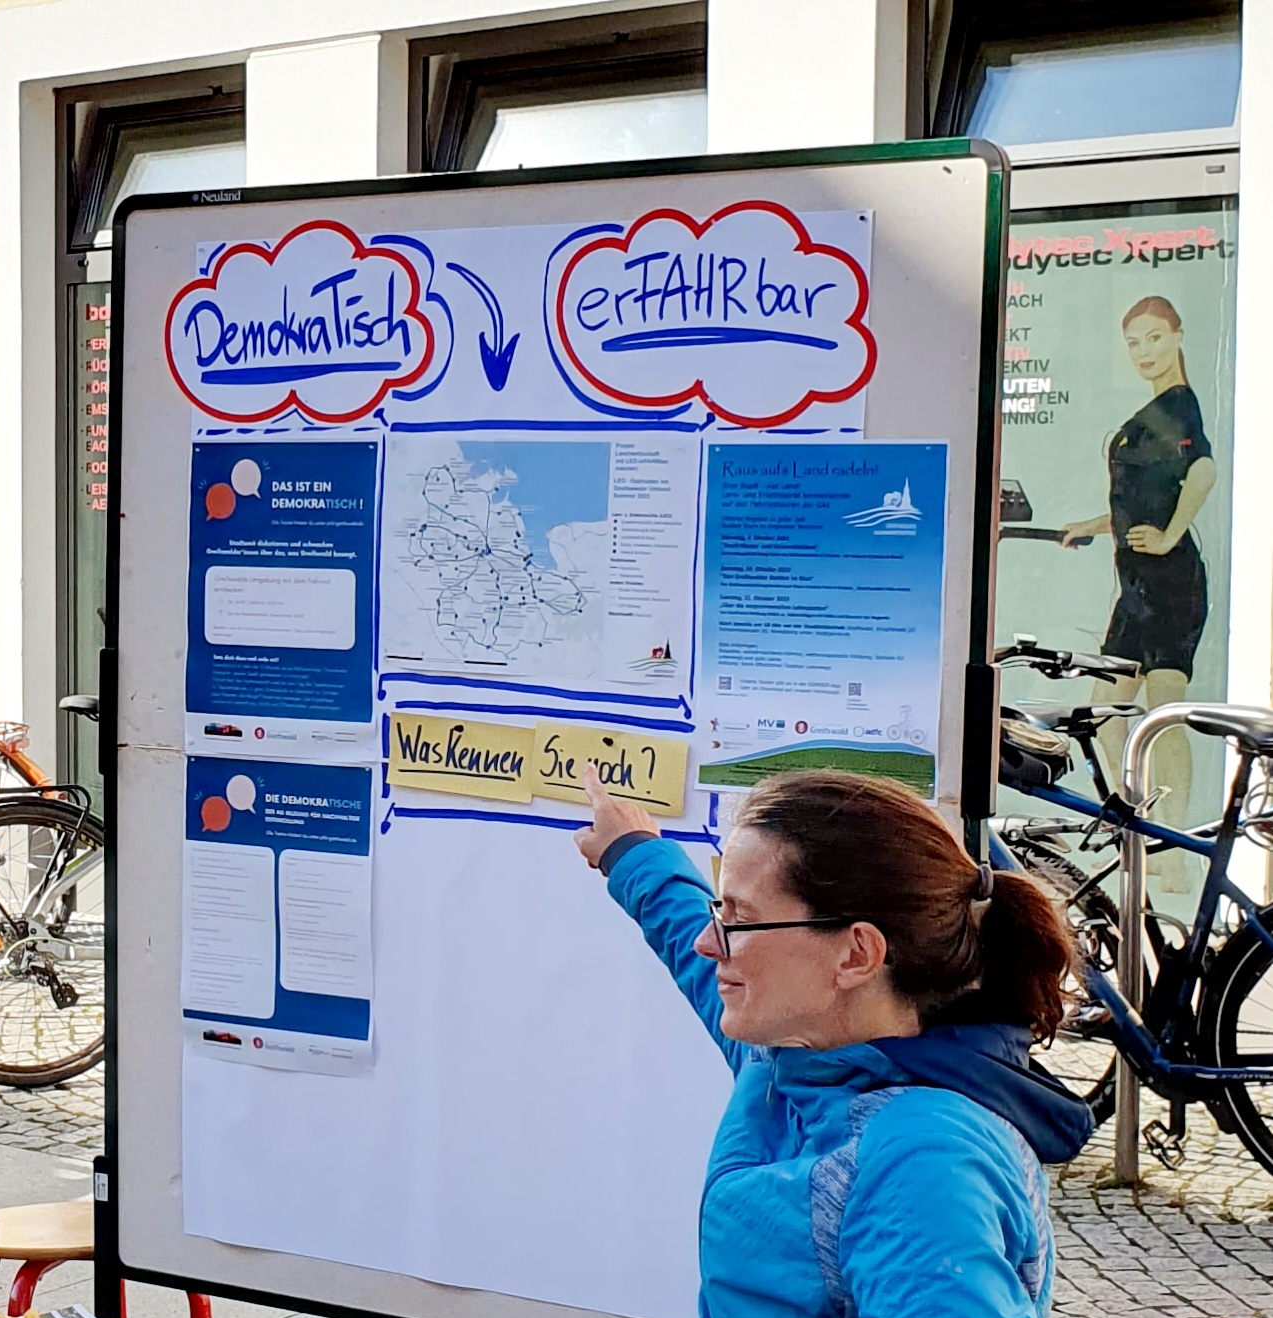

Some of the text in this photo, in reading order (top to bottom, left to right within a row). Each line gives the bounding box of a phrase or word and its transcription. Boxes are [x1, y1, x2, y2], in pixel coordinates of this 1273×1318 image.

[201, 190, 241, 203] Neuland
[722, 460, 758, 478] Raus
[793, 459, 829, 479] Land
[271, 481, 332, 493] DAS IST EIN
[271, 498, 357, 510] DEMOKRATISCH
[757, 718, 775, 728] MV
[396, 722, 443, 765] Was
[539, 734, 577, 780] Sie
[265, 793, 362, 810] DIE DEMOKRATISCHE
